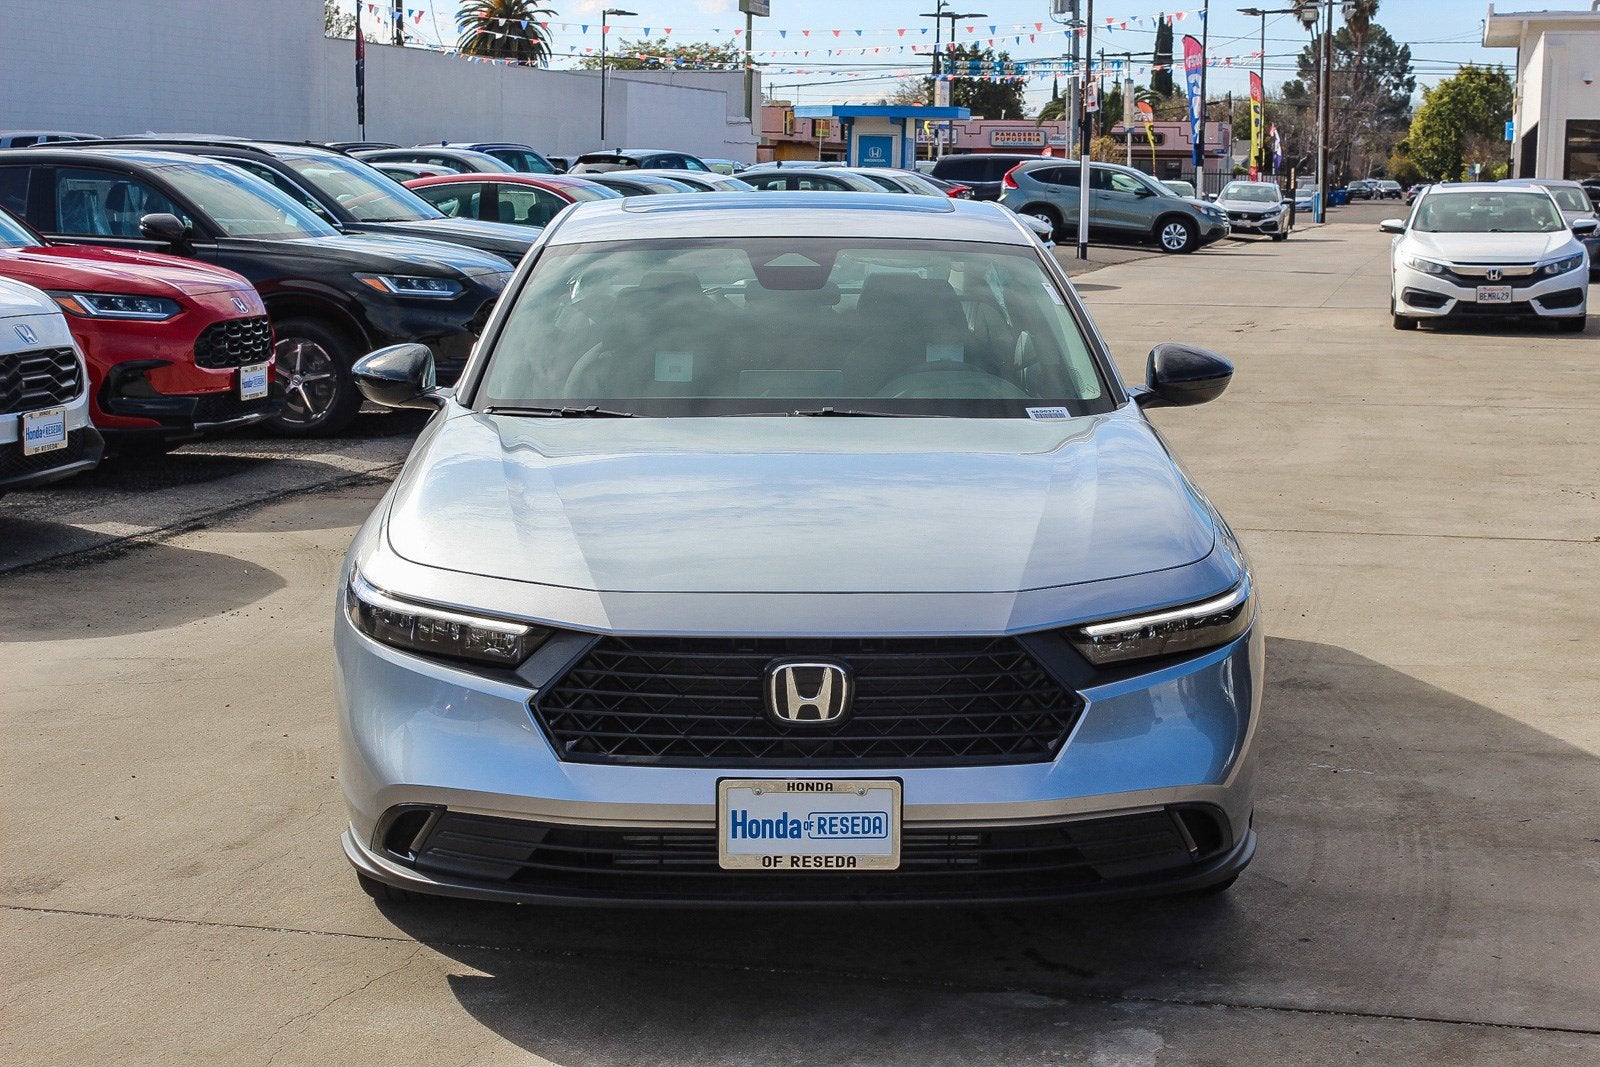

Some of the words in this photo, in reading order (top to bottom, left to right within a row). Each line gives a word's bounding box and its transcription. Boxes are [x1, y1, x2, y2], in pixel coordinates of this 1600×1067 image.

[786, 782, 834, 792] HONDA
[731, 809, 802, 839] Honda
[803, 820, 815, 831] OF
[817, 816, 883, 835] RESEDA
[762, 855, 783, 868] OF
[790, 855, 857, 868] RESEDA
